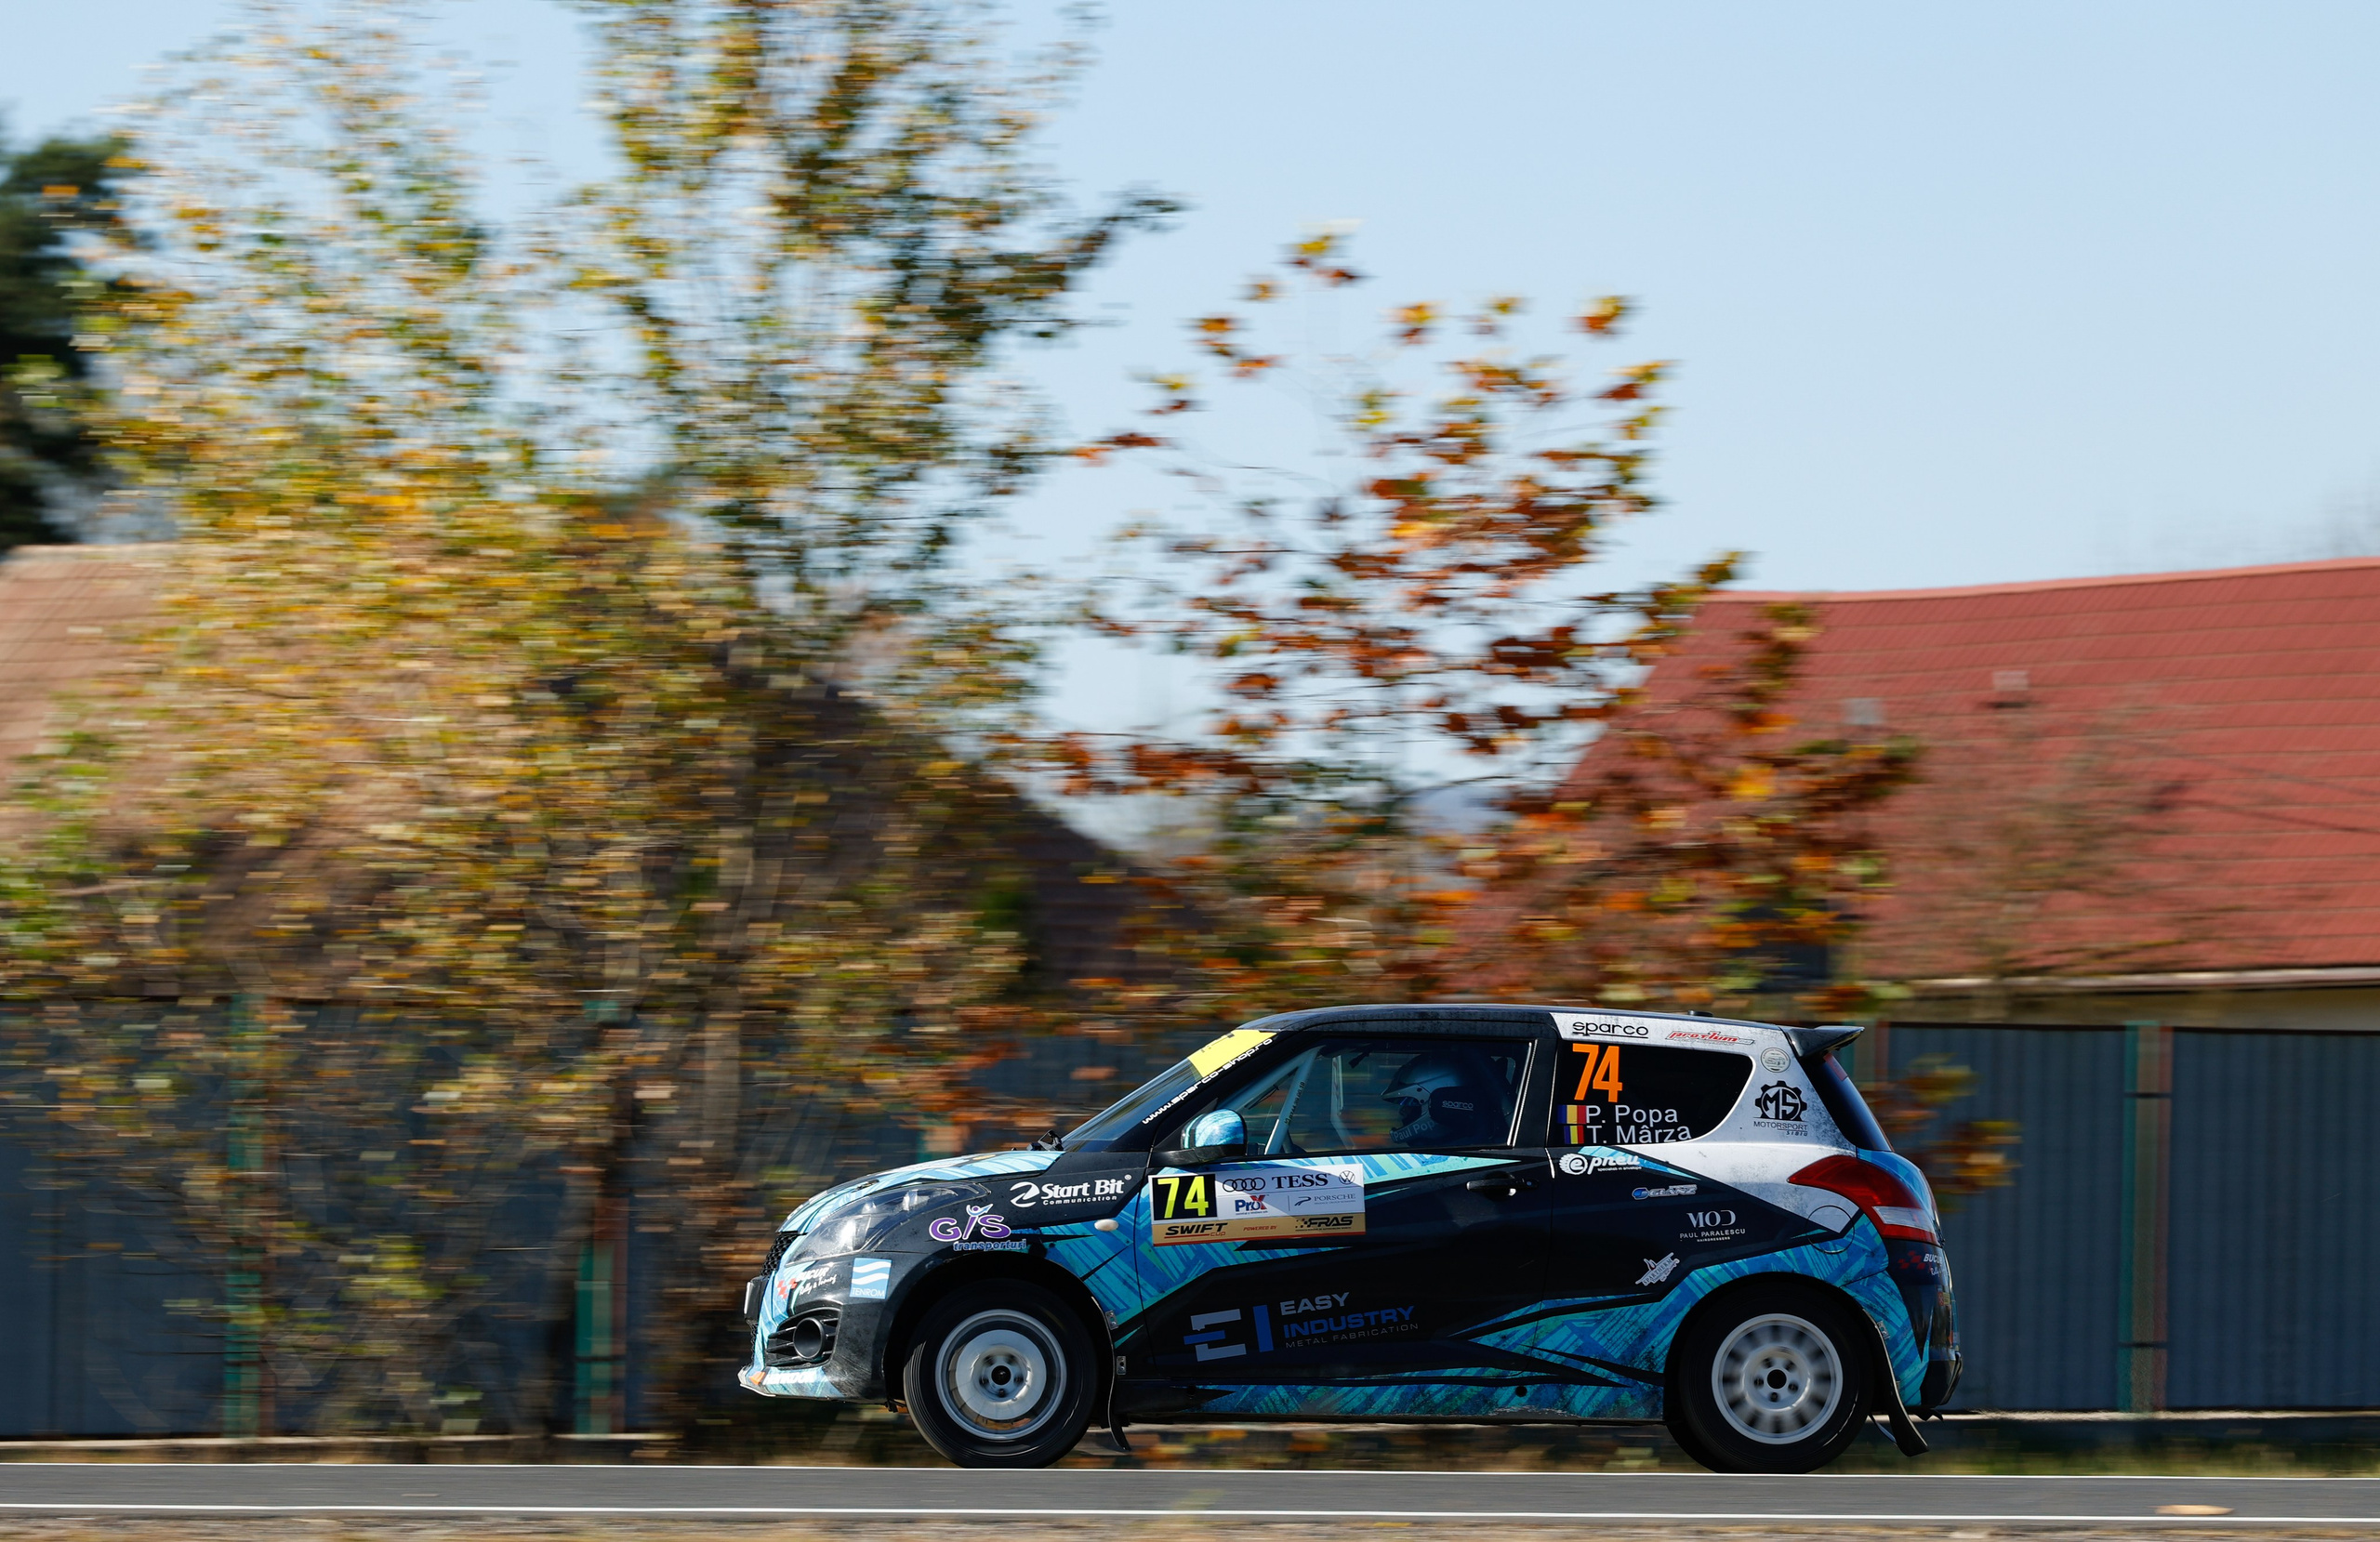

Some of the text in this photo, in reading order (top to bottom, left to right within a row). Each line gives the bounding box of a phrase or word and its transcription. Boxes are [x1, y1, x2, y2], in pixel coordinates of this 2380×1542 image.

[1572, 1021, 1649, 1038] sparco
[1572, 1043, 1623, 1102] 74
[1142, 1038, 1273, 1124] www.sparco-shop.ro
[1441, 1100, 1474, 1111] sparco
[1586, 1105, 1678, 1127] P. Popa
[1394, 1127, 1412, 1141] Paul
[1753, 1121, 1807, 1131] MOTORSPORT
[1587, 1125, 1692, 1144] T. Mârza
[1272, 1173, 1329, 1189] TESS
[1040, 1180, 1124, 1200] Start Bit
[1157, 1176, 1209, 1219] 74
[1314, 1193, 1356, 1202] PORSCHE
[1042, 1196, 1117, 1206] Communication
[1165, 1222, 1228, 1236] SWIFT
[1307, 1216, 1354, 1228] FRAS
[1701, 1229, 1746, 1237] PARALESCU
[953, 1238, 1026, 1252] transporturi
[852, 1288, 885, 1297] TENROM
[1279, 1292, 1350, 1315] EASY
[1283, 1305, 1414, 1338] INDUSTRY
[1285, 1323, 1419, 1348] METAL FABRICATION
